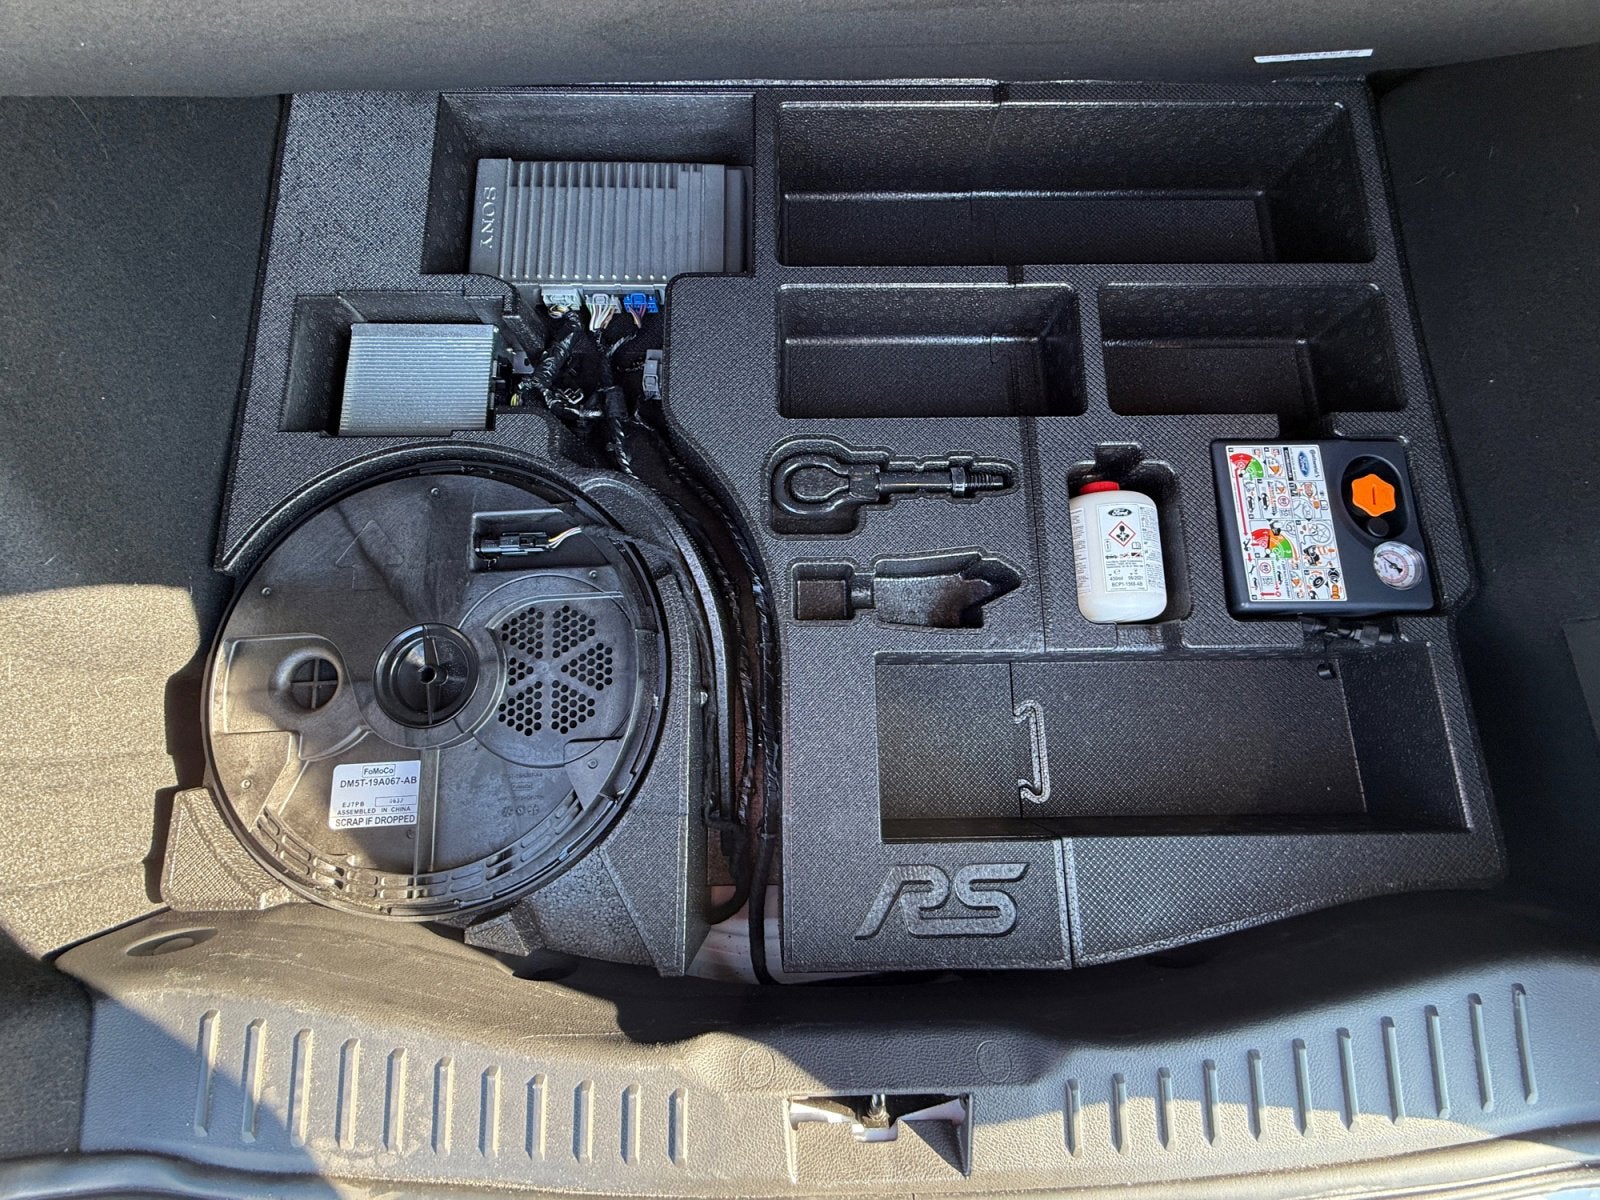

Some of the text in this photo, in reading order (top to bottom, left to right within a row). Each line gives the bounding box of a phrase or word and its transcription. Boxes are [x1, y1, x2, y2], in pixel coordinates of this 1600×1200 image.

[480, 186, 496, 252] SONY
[1109, 508, 1131, 516] Ford
[363, 767, 394, 775] FoMoCo
[340, 776, 417, 788] DM5T-19A067-AB
[336, 815, 416, 827] SCRAP IF DROPPED
[854, 862, 1030, 940] RS
